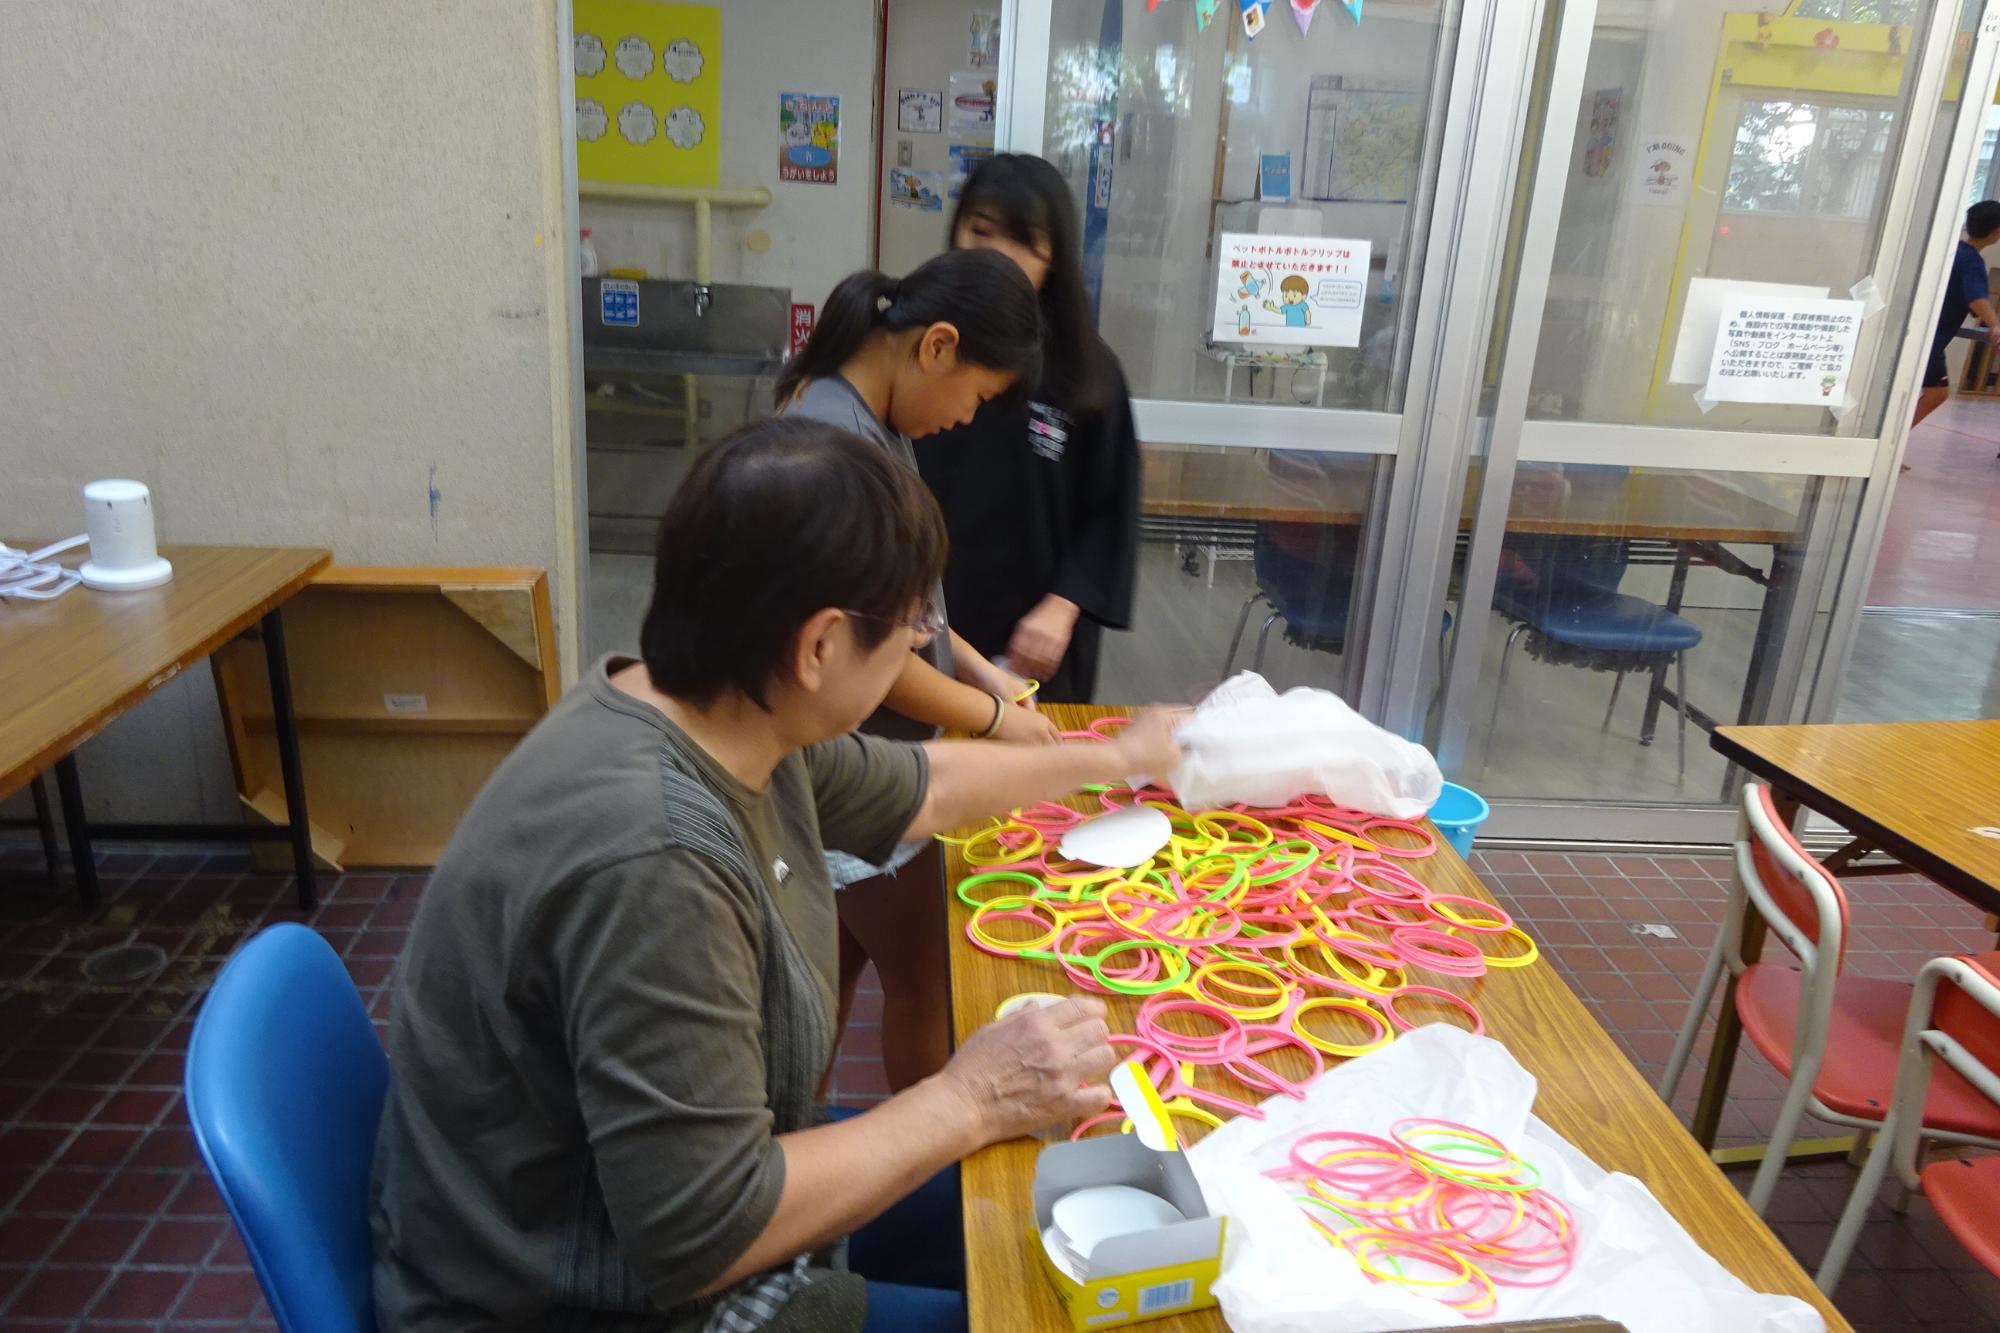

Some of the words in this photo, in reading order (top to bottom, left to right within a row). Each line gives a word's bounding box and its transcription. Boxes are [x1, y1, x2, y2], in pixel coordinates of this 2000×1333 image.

[783, 167, 835, 182] うがいをしよう
[1232, 245, 1351, 259] ペットボトルボトルフリップは
[795, 308, 811, 355] 消火
[1728, 330, 1834, 342] 写真や動画をインターネット上
